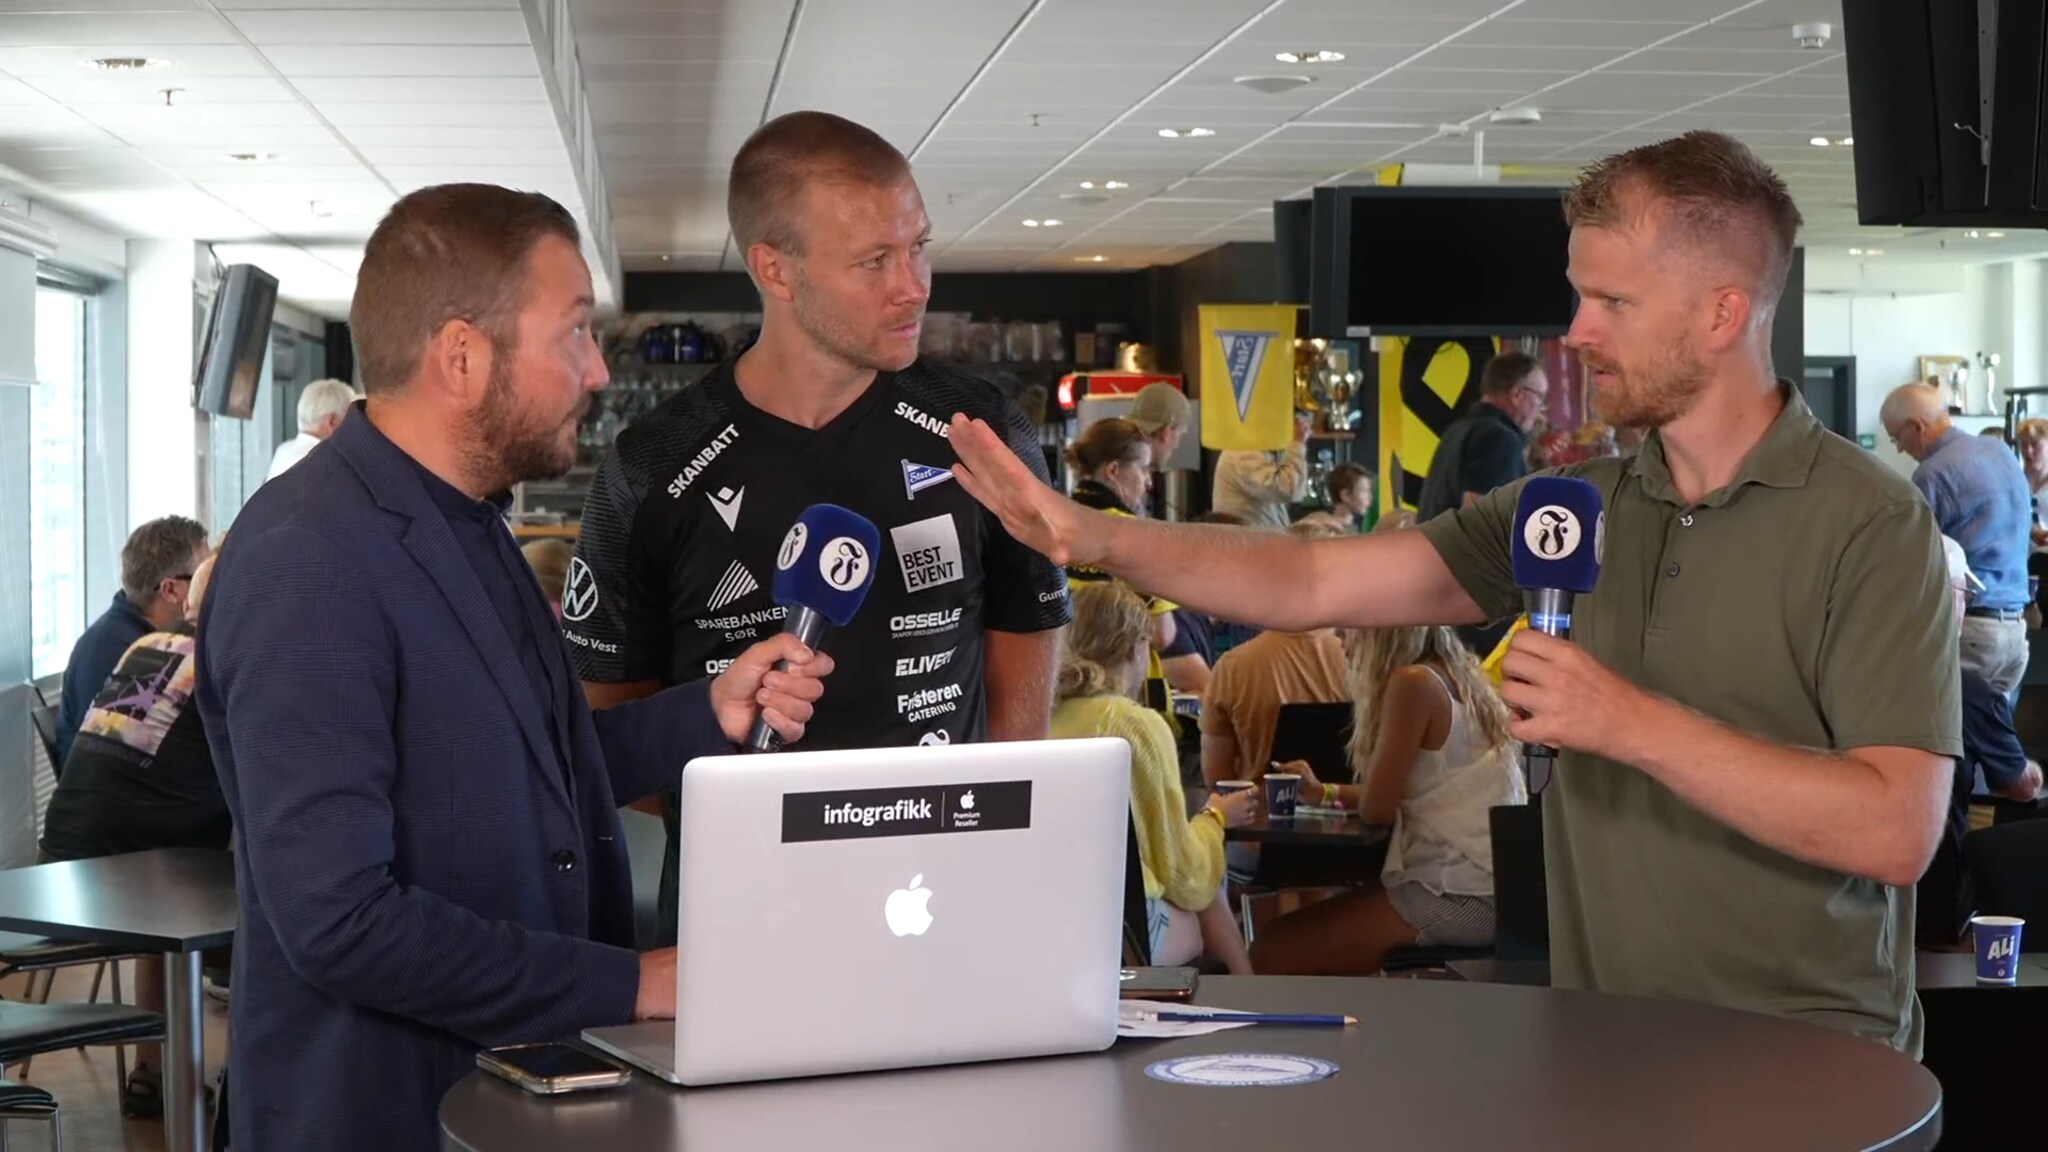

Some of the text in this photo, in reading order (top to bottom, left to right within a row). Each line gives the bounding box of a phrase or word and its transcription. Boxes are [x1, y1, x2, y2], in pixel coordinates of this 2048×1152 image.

[667, 423, 740, 499] SKANBATT
[902, 546, 941, 570] BEST
[907, 561, 954, 589] EVENT
[890, 607, 963, 632] OSSELLE
[566, 630, 588, 646] Auto
[590, 638, 617, 653] Vest
[725, 627, 757, 642] SØR
[908, 702, 956, 723] CATERING
[824, 799, 932, 827] infografikk
[953, 811, 981, 820] Premium
[955, 819, 978, 827] Reseller
